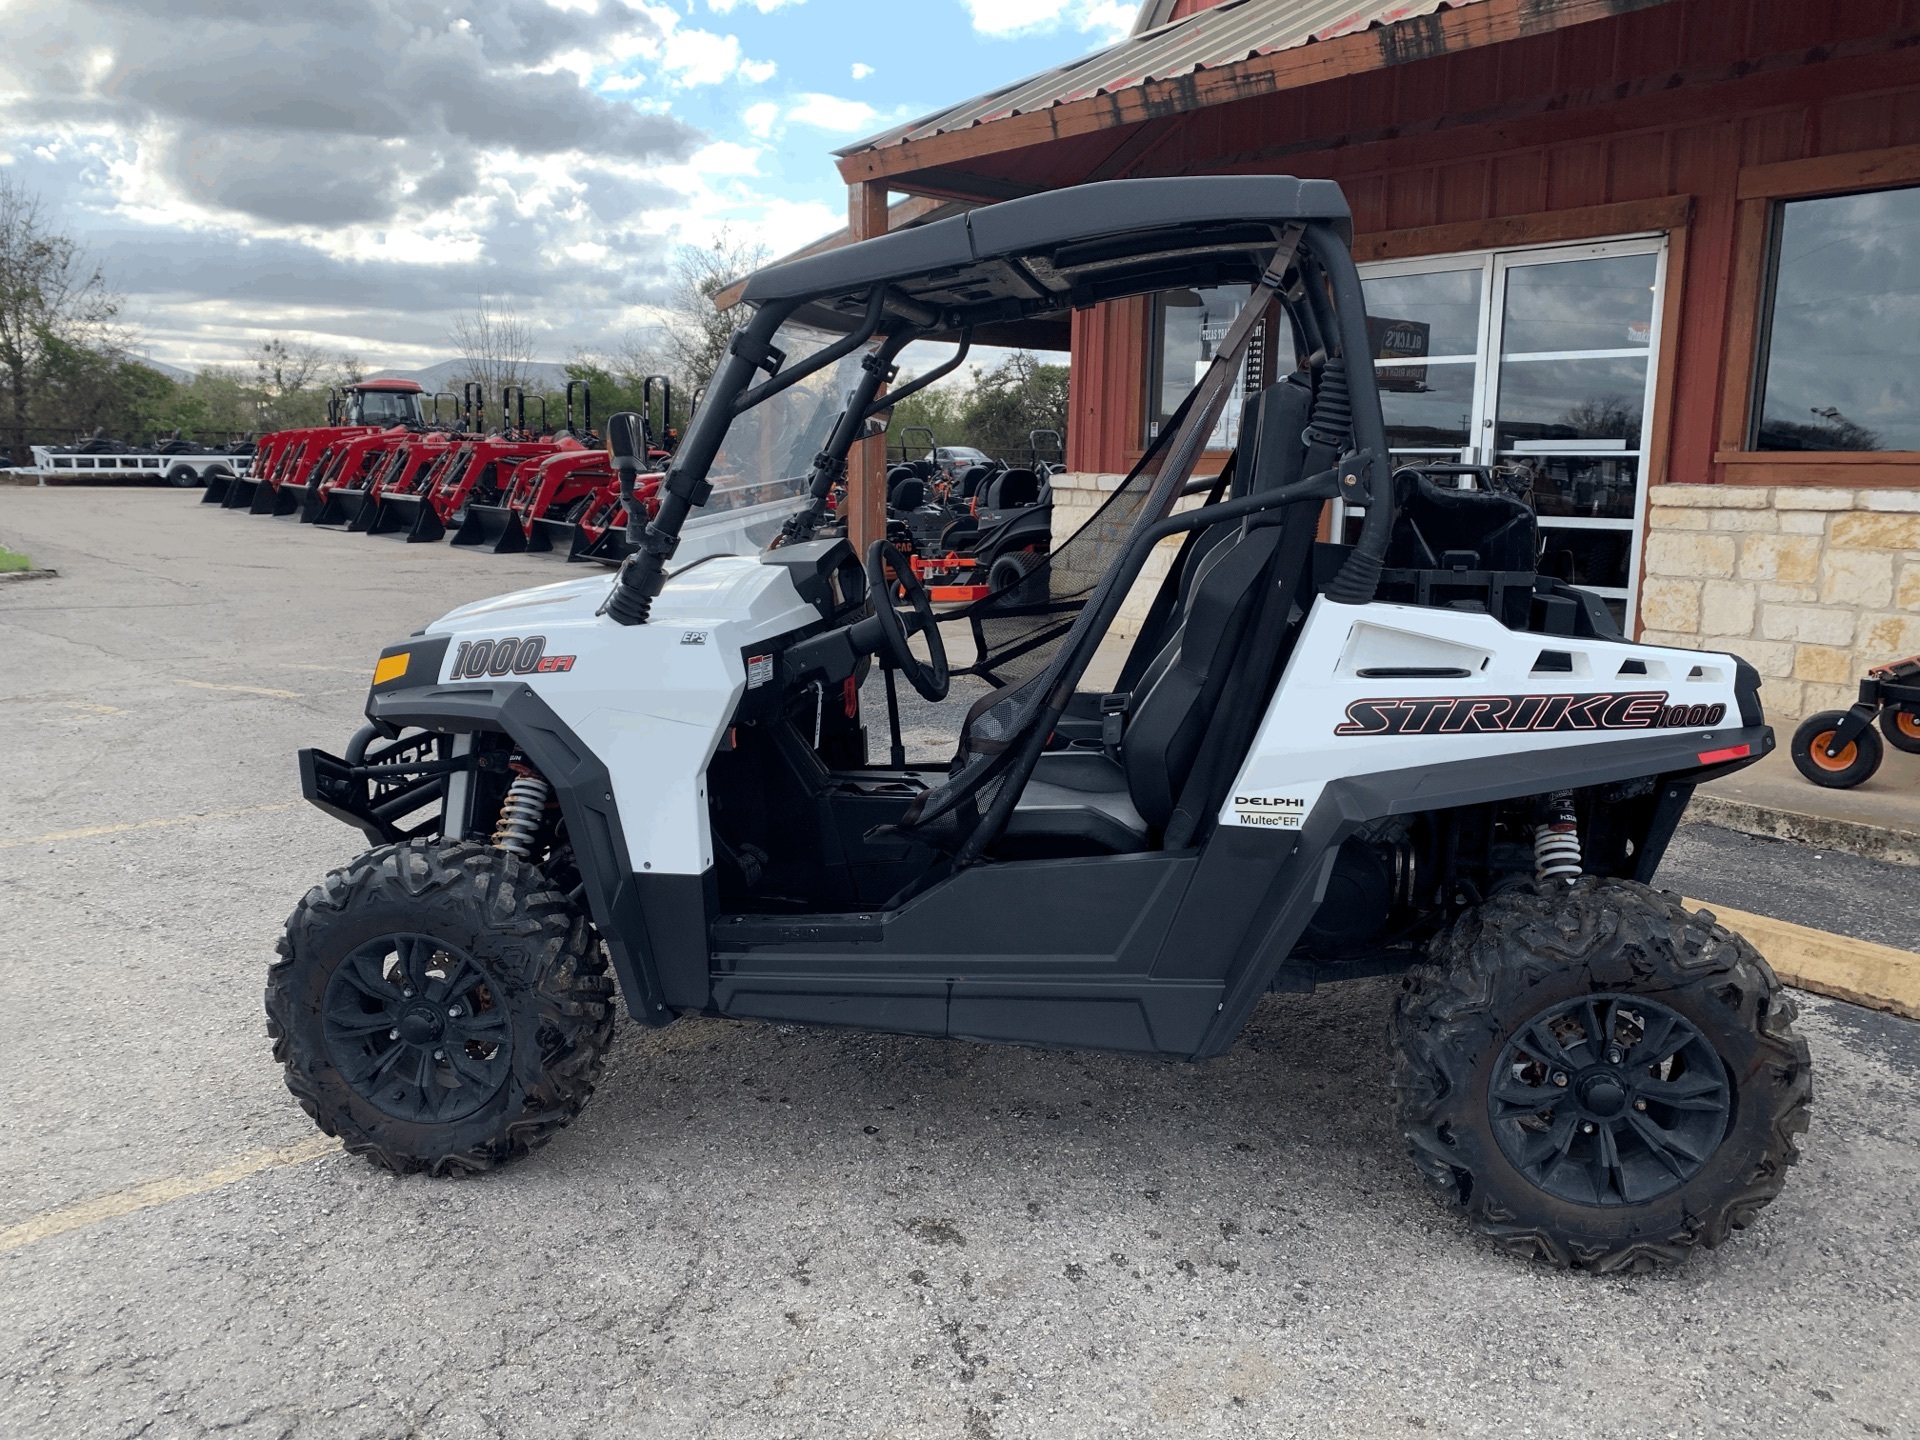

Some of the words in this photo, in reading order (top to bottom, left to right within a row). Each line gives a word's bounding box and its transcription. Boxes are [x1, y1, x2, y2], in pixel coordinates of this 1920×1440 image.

[893, 542, 912, 552] CAG
[681, 631, 708, 643] EPS
[450, 635, 547, 680] 1000
[537, 655, 577, 674] EFI
[1334, 691, 1669, 736] STRIKE
[1656, 703, 1727, 729] 1000
[1234, 796, 1304, 807] DELPHI
[1283, 817, 1299, 826] EFI
